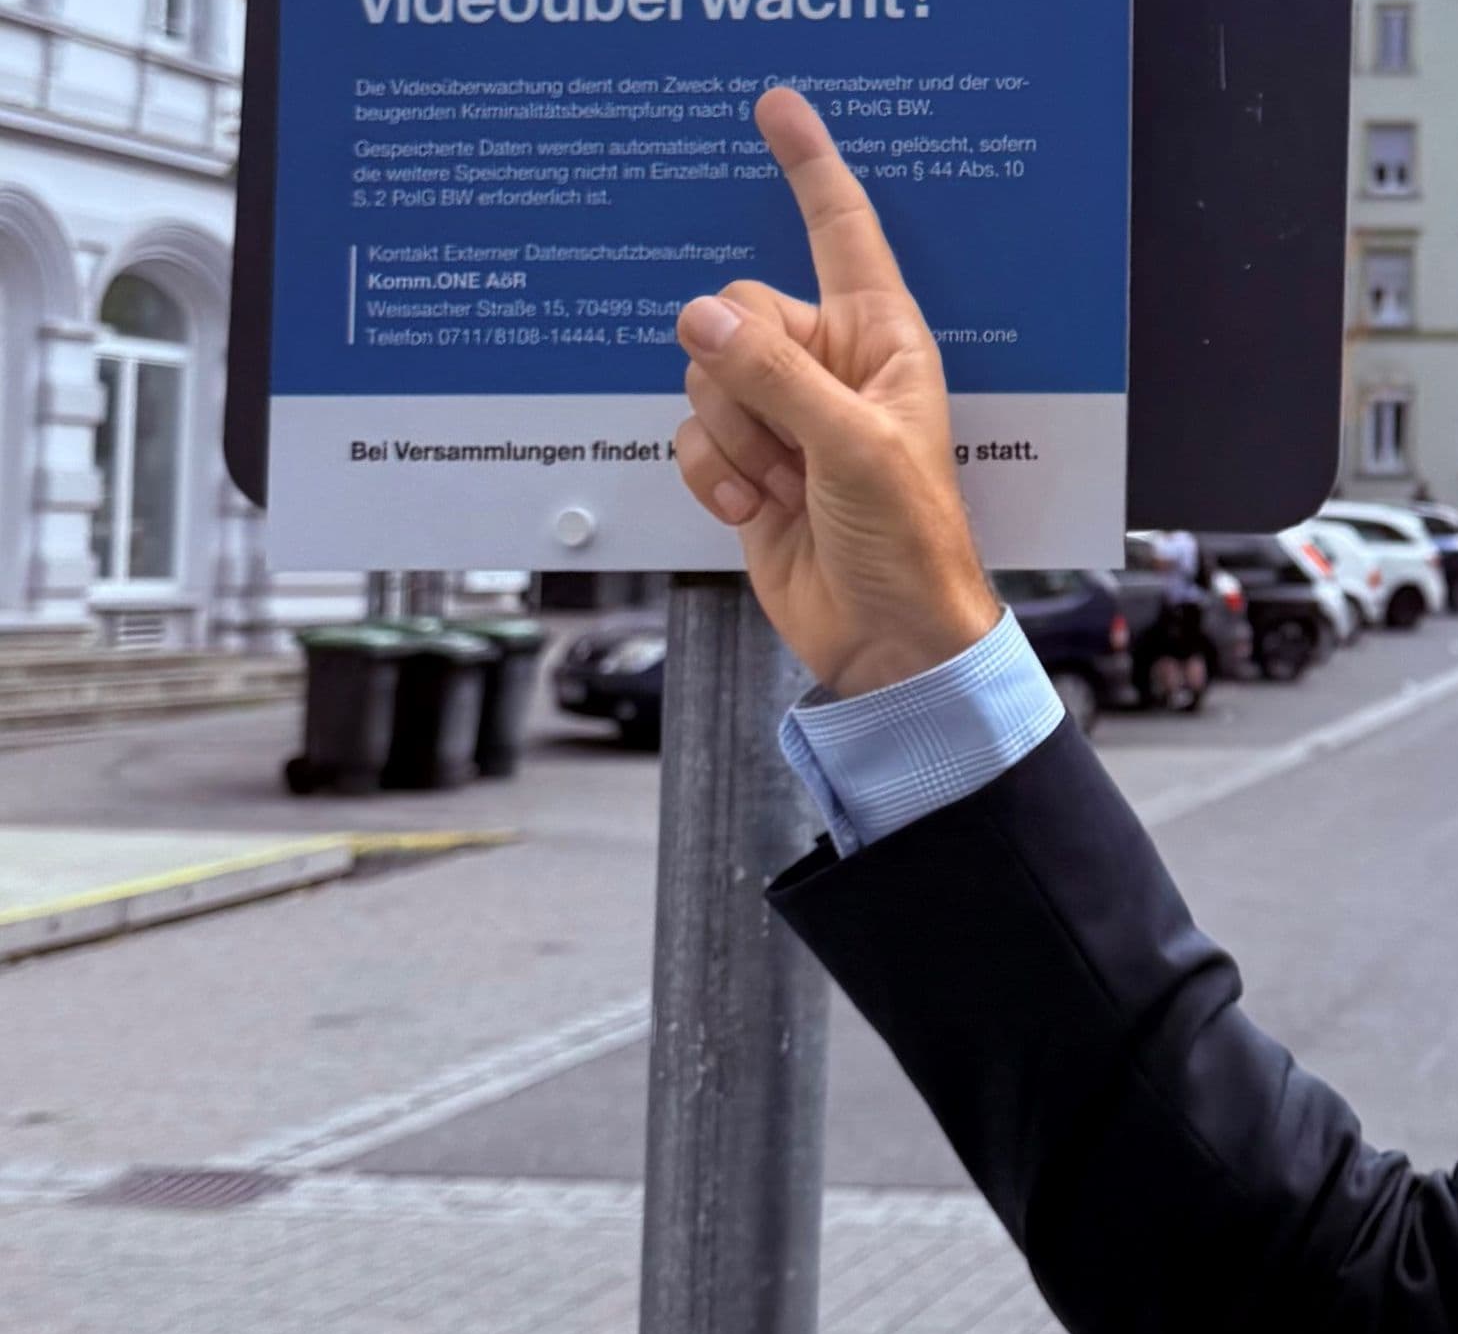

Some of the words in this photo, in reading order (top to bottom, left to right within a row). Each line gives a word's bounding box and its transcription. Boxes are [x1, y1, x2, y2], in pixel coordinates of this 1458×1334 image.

[355, 78, 386, 96] Die
[390, 76, 563, 99] Videoüberwachung
[568, 77, 612, 95] dient
[617, 77, 659, 94] dem
[663, 75, 723, 94] Zweck
[728, 76, 758, 93] der
[919, 73, 954, 90] und
[959, 73, 989, 90] der
[995, 76, 1030, 90] vor-
[355, 104, 457, 125] beugenden
[462, 101, 684, 123] Kriminalitätsbekämpfung
[688, 100, 733, 117] nach
[738, 99, 749, 121] §
[830, 99, 841, 117] 3
[848, 99, 892, 116] PolG
[897, 98, 933, 116] BW.
[355, 138, 473, 160] Gespeicherte
[479, 137, 533, 156] Daten
[538, 137, 604, 156] werden
[608, 135, 726, 155] automatisiert
[732, 137, 770, 154] nac
[890, 135, 973, 158] gelöscht,
[979, 134, 1037, 153] sofern
[353, 164, 381, 182] die
[386, 163, 451, 181] weitere
[455, 163, 570, 185] Speicherung
[574, 162, 618, 180] nicht
[622, 162, 645, 179] im
[649, 161, 728, 179] Einzelfall
[734, 162, 778, 179] nach
[874, 165, 907, 178] von
[913, 160, 924, 181] §
[930, 161, 952, 177] 44
[959, 160, 999, 177] Abs.
[1004, 159, 1024, 177] 10
[353, 188, 371, 208] S.
[375, 189, 387, 207] 2
[392, 187, 436, 206] PolG
[440, 187, 474, 206] BW
[478, 187, 581, 206] erforderlich
[586, 187, 612, 205] ist.
[368, 244, 440, 262] Kontakt
[444, 243, 519, 262] Externer
[524, 242, 756, 264] Datenschutzbeauftragter:
[368, 273, 480, 290] Komm.ONE
[486, 271, 527, 289] AöR
[366, 299, 471, 318] Weissacher
[475, 298, 537, 317] Straße
[543, 299, 570, 318] 15,
[576, 298, 632, 317] 70499
[637, 298, 681, 316] Stutt
[367, 327, 433, 346] Telefon
[351, 441, 388, 460] Bei
[395, 440, 587, 465] Versammlungen
[592, 440, 664, 461] findet
[976, 440, 1039, 460] statt.
